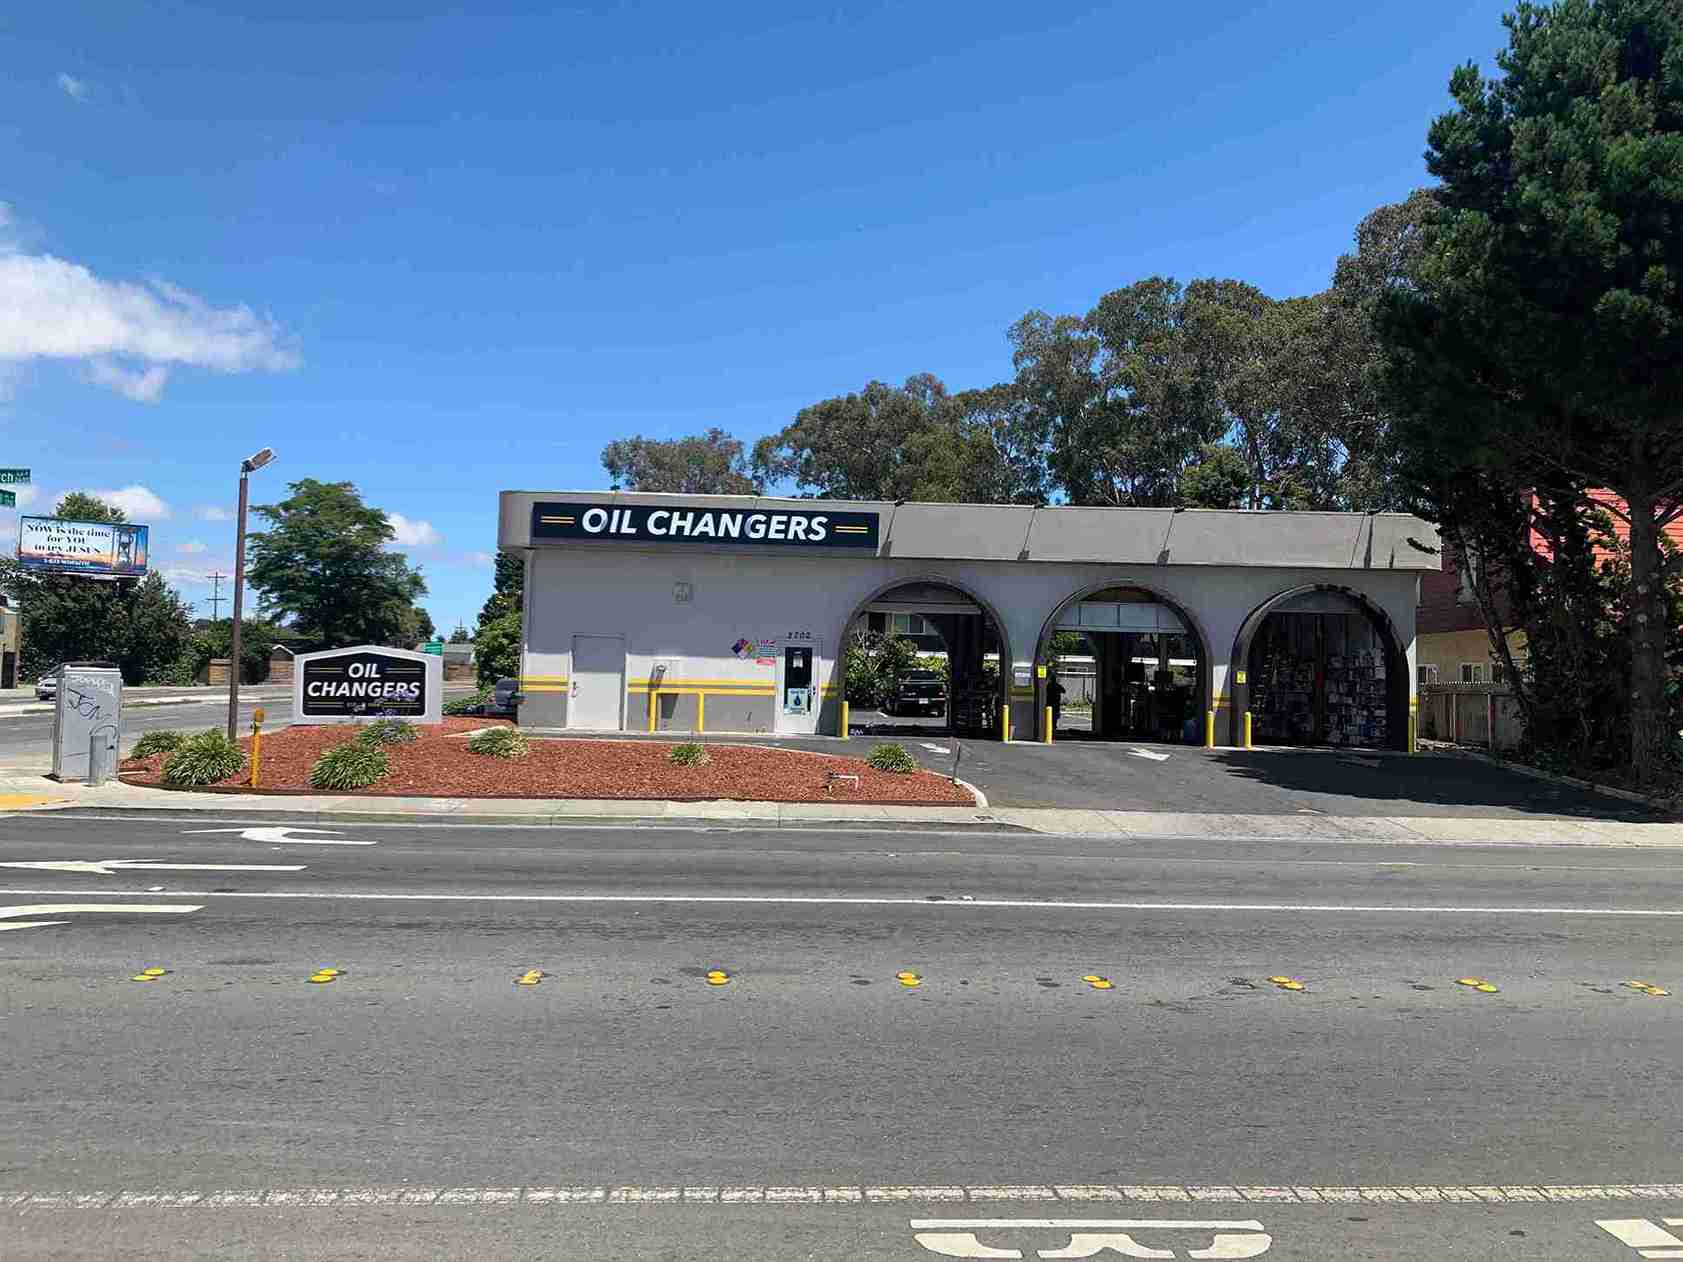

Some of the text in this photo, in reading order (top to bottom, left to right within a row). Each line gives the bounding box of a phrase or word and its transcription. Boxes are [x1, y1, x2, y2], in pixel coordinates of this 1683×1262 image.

[582, 508, 828, 542] OIL CHANGERS
[348, 662, 381, 678] OIL
[307, 682, 420, 698] CHANGERS
